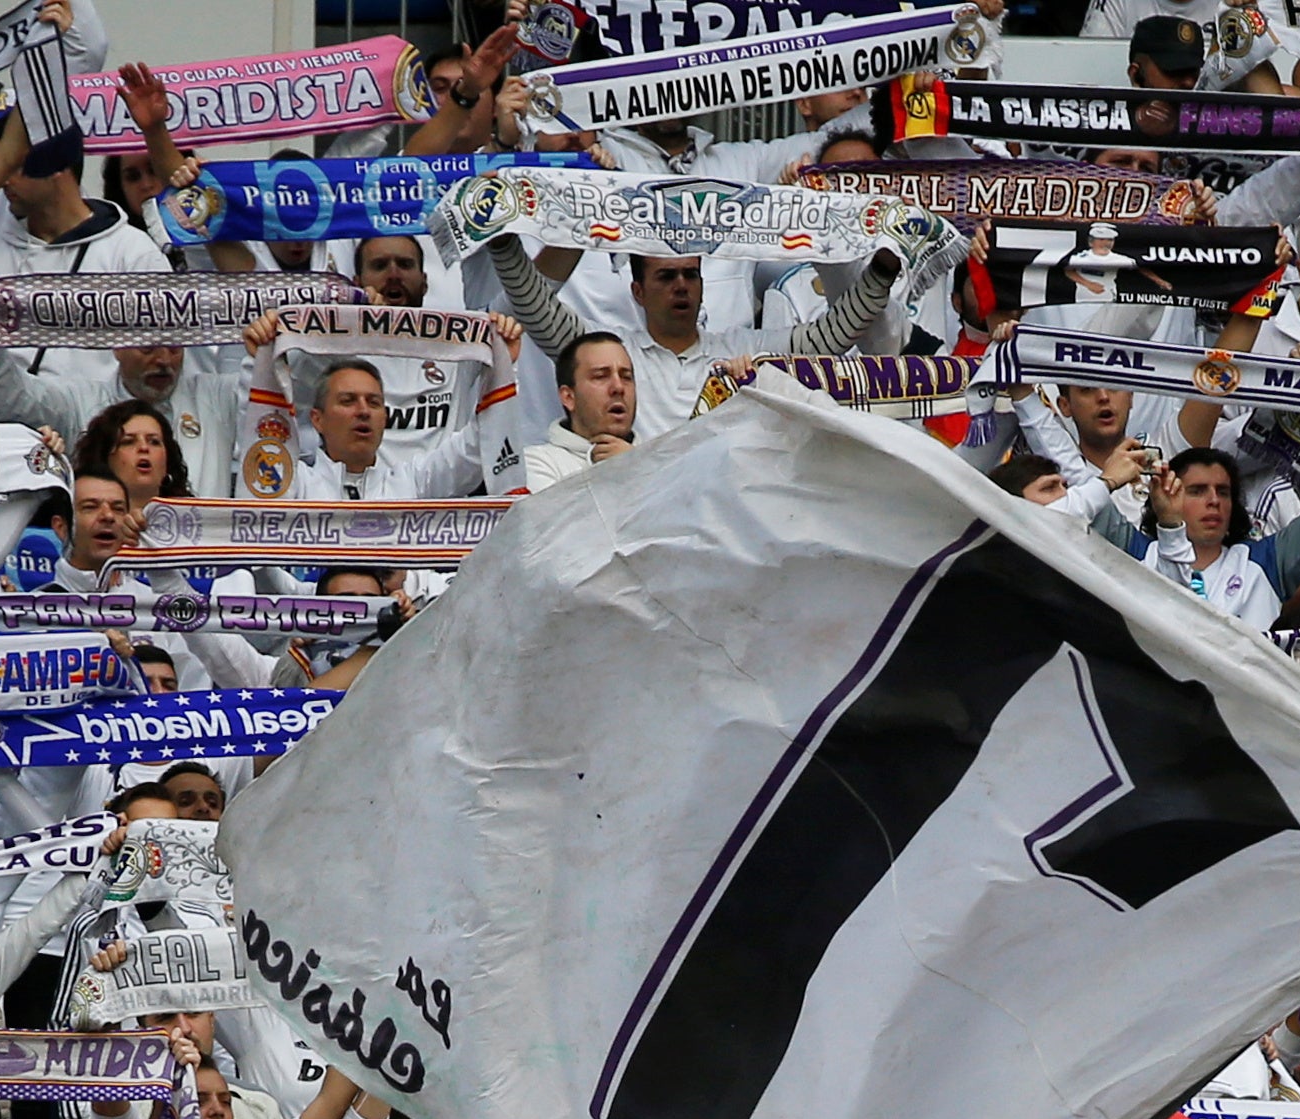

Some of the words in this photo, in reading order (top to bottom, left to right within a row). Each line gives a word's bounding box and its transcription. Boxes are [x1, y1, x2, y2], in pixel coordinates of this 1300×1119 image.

[677, 53, 721, 69] PEÑA
[727, 34, 827, 62] MADRIDISTA
[245, 61, 285, 76] LISTA
[590, 87, 621, 123] LA
[628, 73, 734, 118] ALMUNIA
[741, 69, 773, 100] DE
[781, 52, 846, 94] DOÑA
[855, 37, 939, 82] GODINA
[953, 97, 992, 124] LA
[244, 184, 310, 208] Peña
[571, 183, 666, 221] Real
[682, 191, 831, 230] Madrid
[969, 175, 1154, 219] MADRID
[623, 225, 695, 244] Santiago
[701, 227, 779, 246] Bernabeu
[997, 228, 1077, 307] 7
[1141, 245, 1261, 264] JUANITO
[1120, 293, 1133, 304] TU
[1136, 294, 1172, 305] NUNCA
[1191, 297, 1230, 310] FUISTE
[1056, 343, 1155, 372] REAL
[232, 512, 338, 543] REAL
